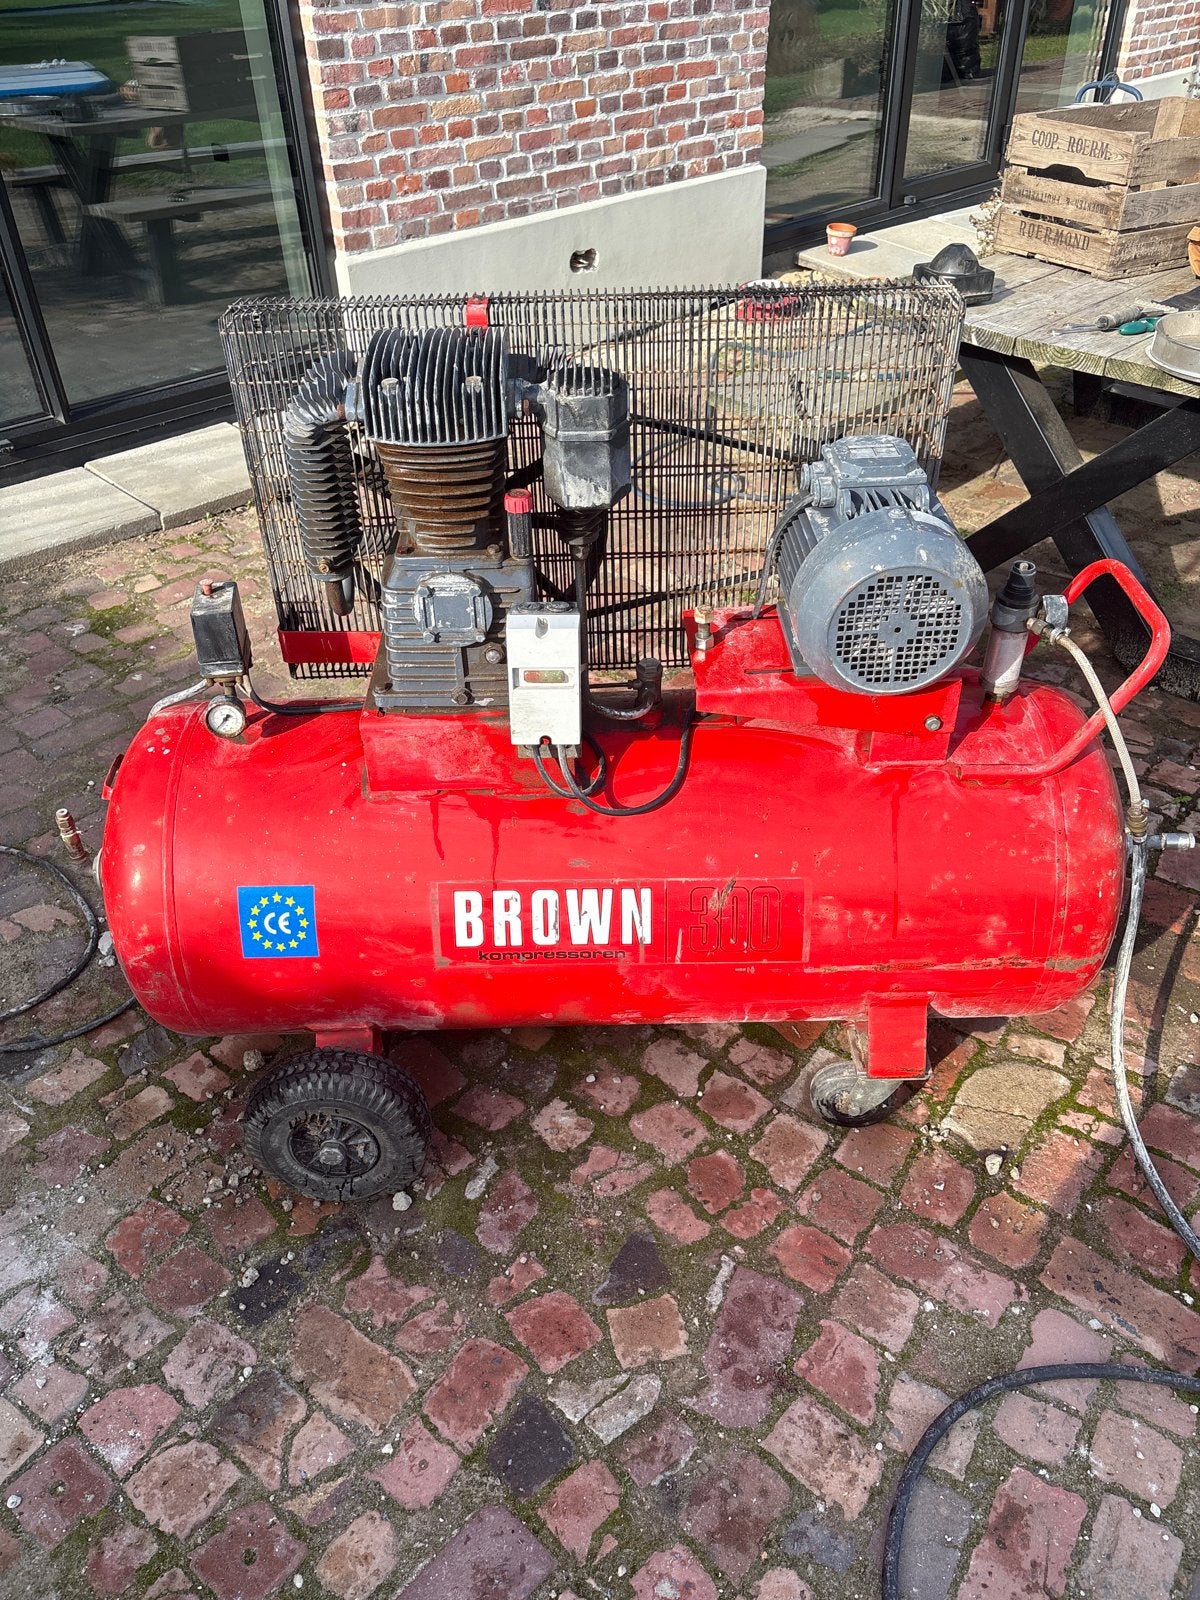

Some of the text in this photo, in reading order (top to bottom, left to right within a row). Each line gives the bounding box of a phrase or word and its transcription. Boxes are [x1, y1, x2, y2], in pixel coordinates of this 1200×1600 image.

[1031, 129, 1060, 150] COOP.
[1018, 220, 1090, 251] ROERMOND
[263, 912, 292, 935] CE
[453, 887, 652, 948] BROWN
[690, 886, 781, 952] 300
[478, 950, 626, 963] kompressoren
